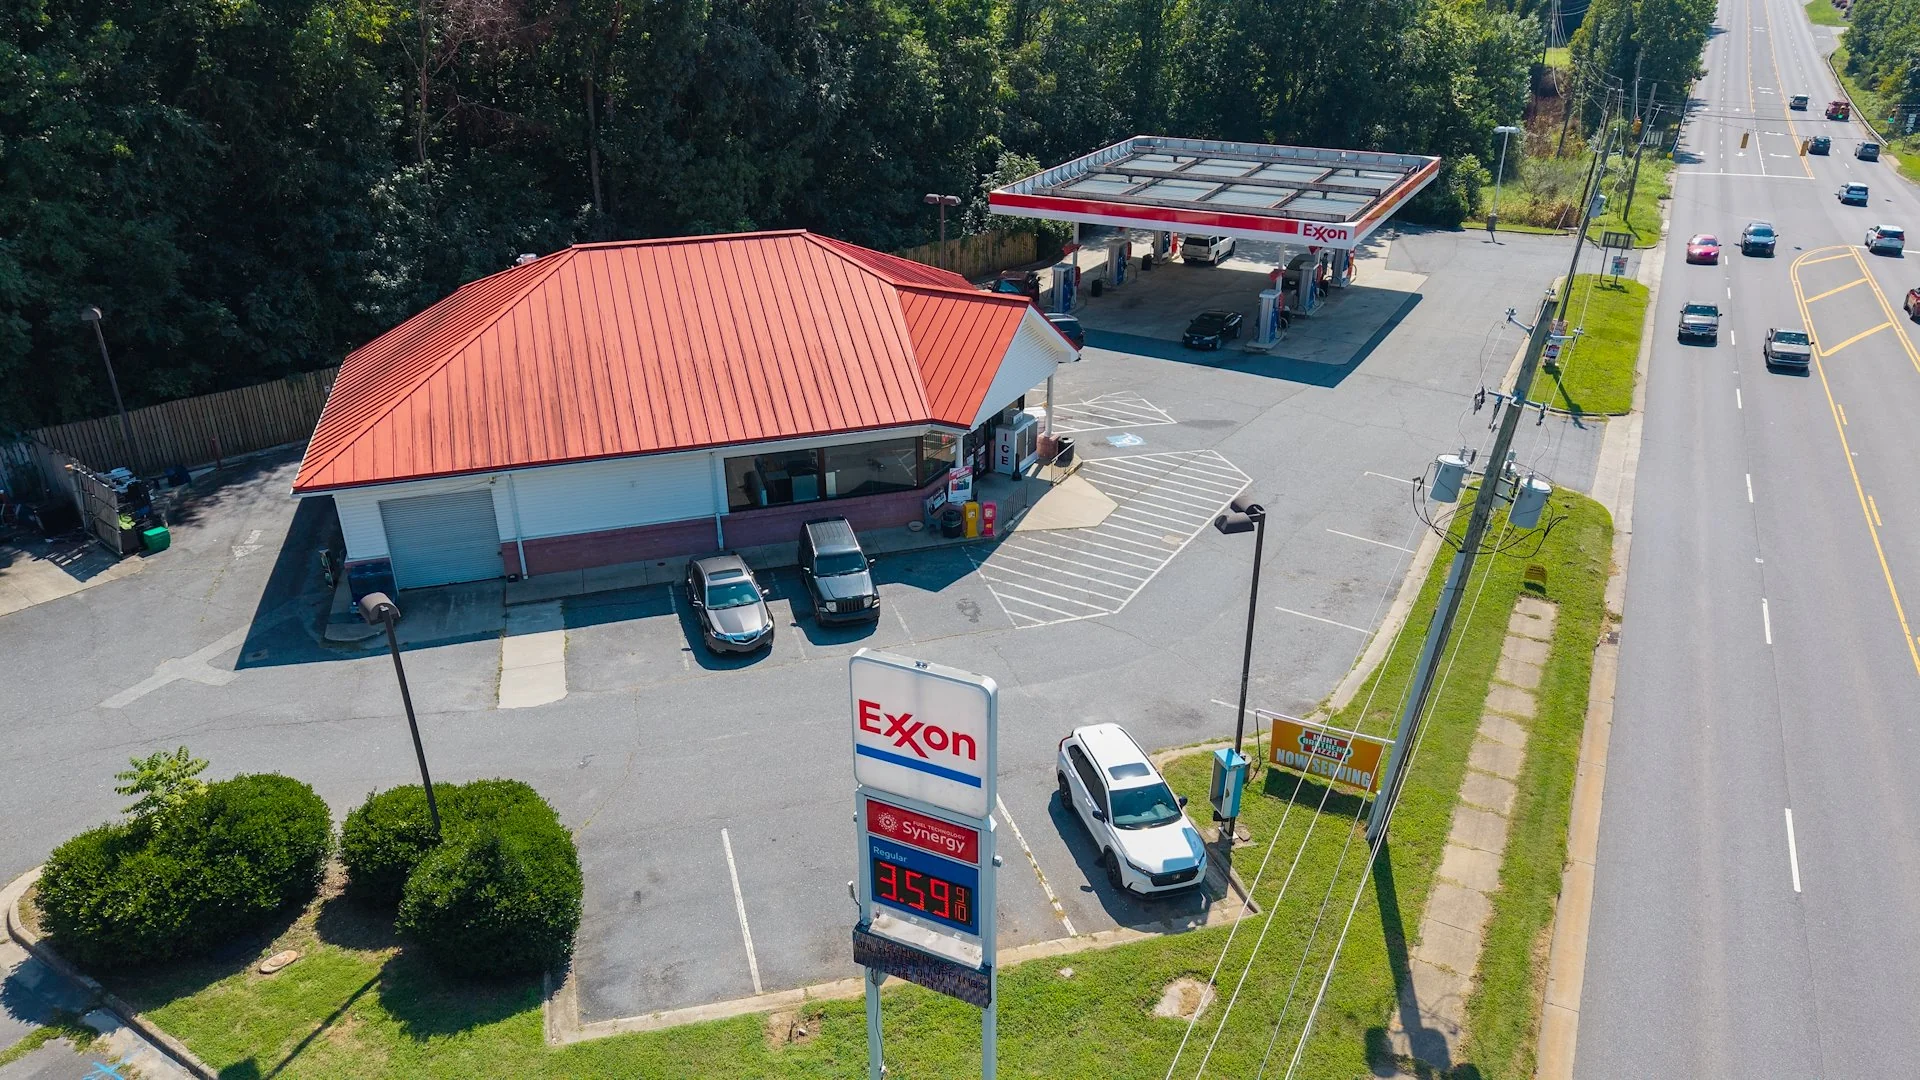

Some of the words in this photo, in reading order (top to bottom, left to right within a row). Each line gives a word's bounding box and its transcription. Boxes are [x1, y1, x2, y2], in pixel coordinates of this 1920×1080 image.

[1303, 223, 1347, 243] Exxon
[1001, 433, 1009, 466] ICE
[859, 698, 977, 761] Exxon
[1276, 748, 1309, 769] NOW
[1312, 758, 1371, 788] SERVING
[903, 821, 965, 853] Synergy
[913, 821, 927, 829] FUEL
[928, 825, 965, 839] TECHNOLOGY
[873, 845, 908, 862] Regular
[880, 861, 950, 918] 3.59
